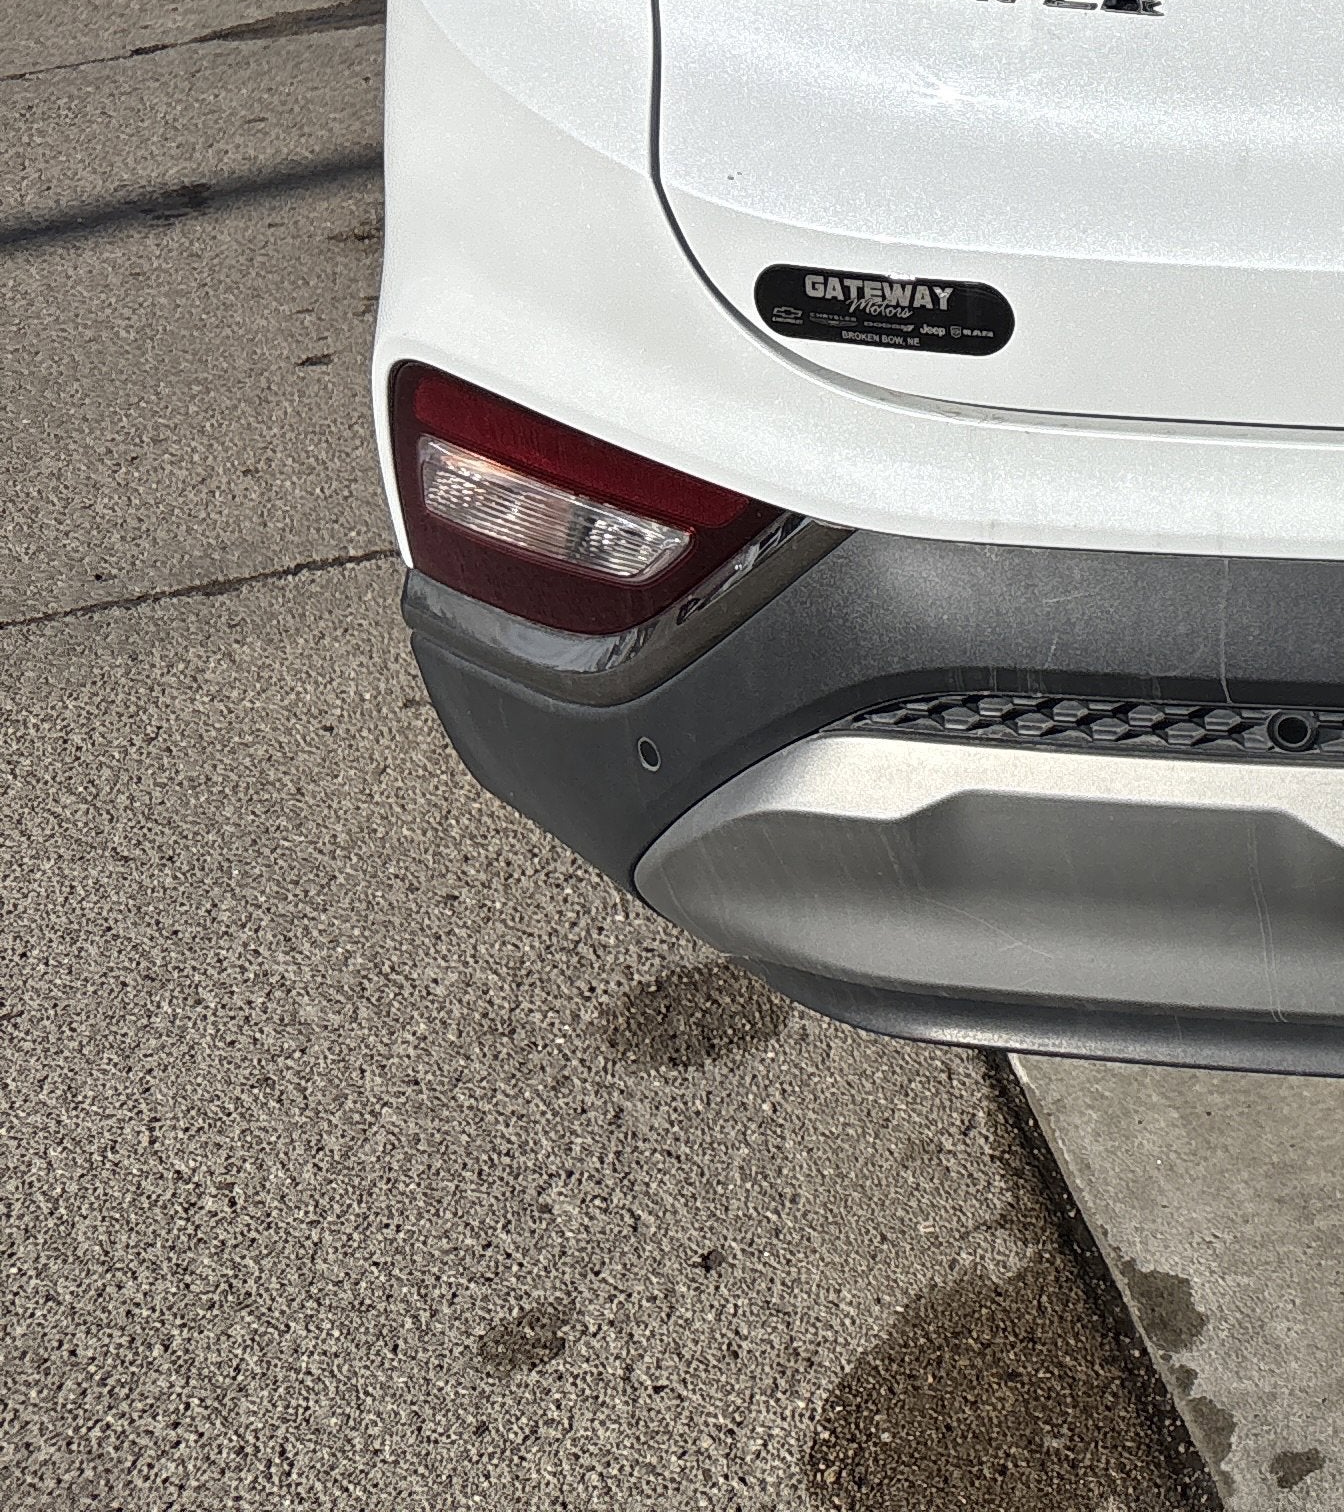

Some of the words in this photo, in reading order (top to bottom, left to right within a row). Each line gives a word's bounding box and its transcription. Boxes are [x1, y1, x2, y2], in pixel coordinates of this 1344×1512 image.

[804, 274, 954, 311] GATEWAY
[846, 296, 913, 318] Motors
[841, 330, 879, 343] BROKEN
[920, 323, 946, 337] Jeep
